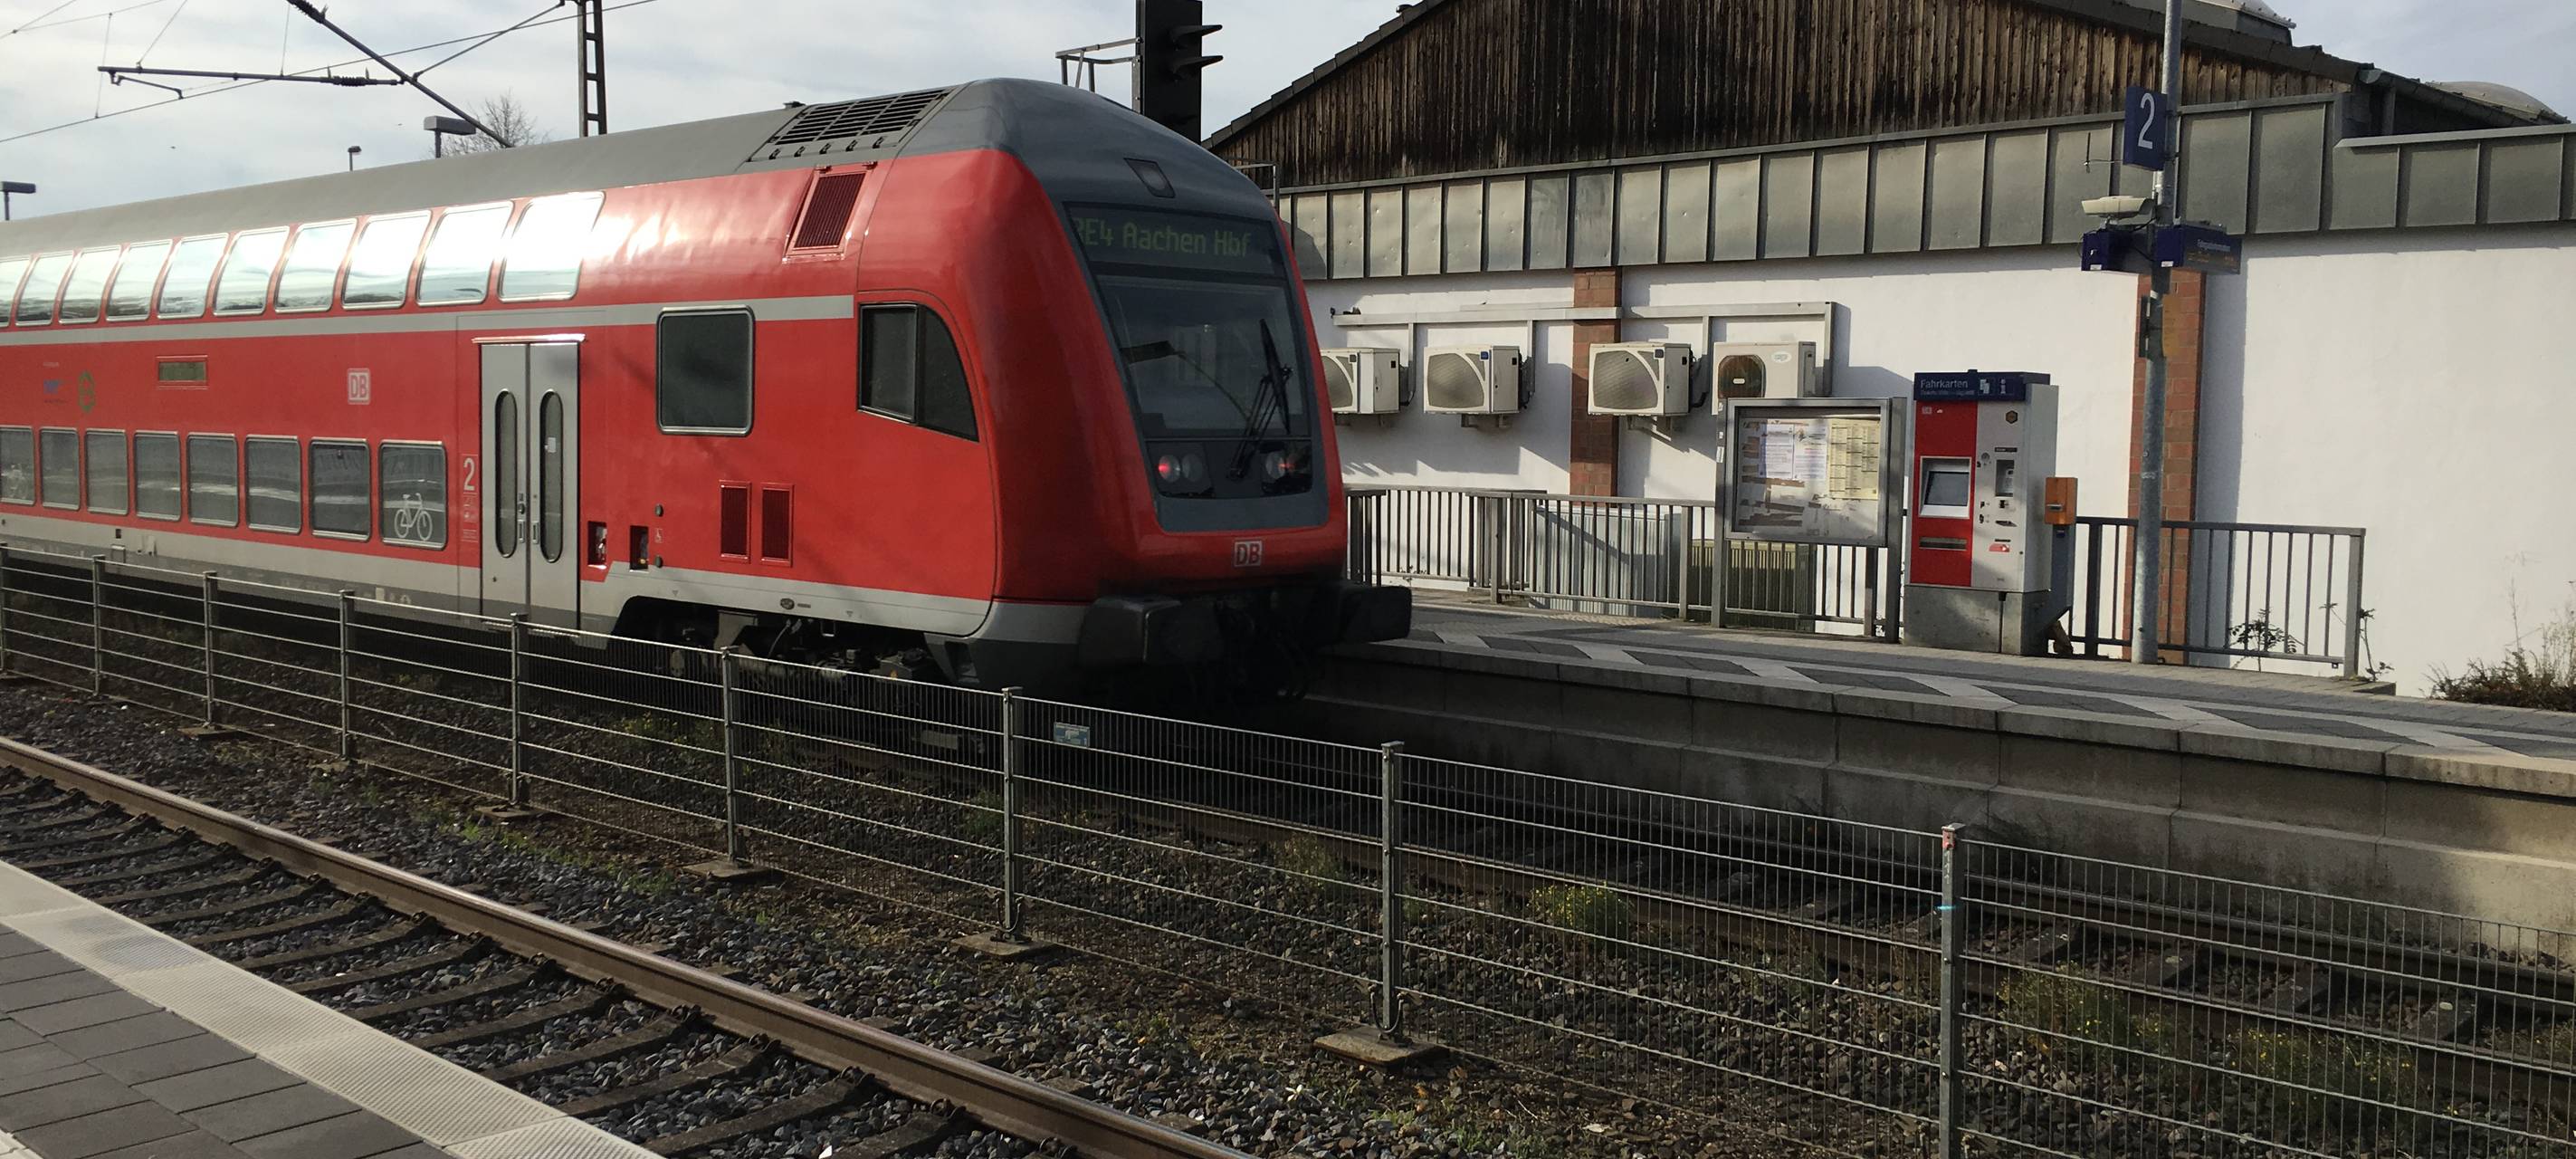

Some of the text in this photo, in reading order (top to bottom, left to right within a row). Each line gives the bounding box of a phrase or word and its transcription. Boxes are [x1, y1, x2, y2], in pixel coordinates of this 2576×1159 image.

[2138, 92, 2155, 149] 2
[1122, 222, 1207, 254] Aachen
[1214, 229, 1252, 258] Hbf
[350, 373, 368, 399] DB
[1920, 378, 1969, 389] Fahrkarten
[463, 457, 475, 491] 2
[1236, 542, 1260, 566] DB
